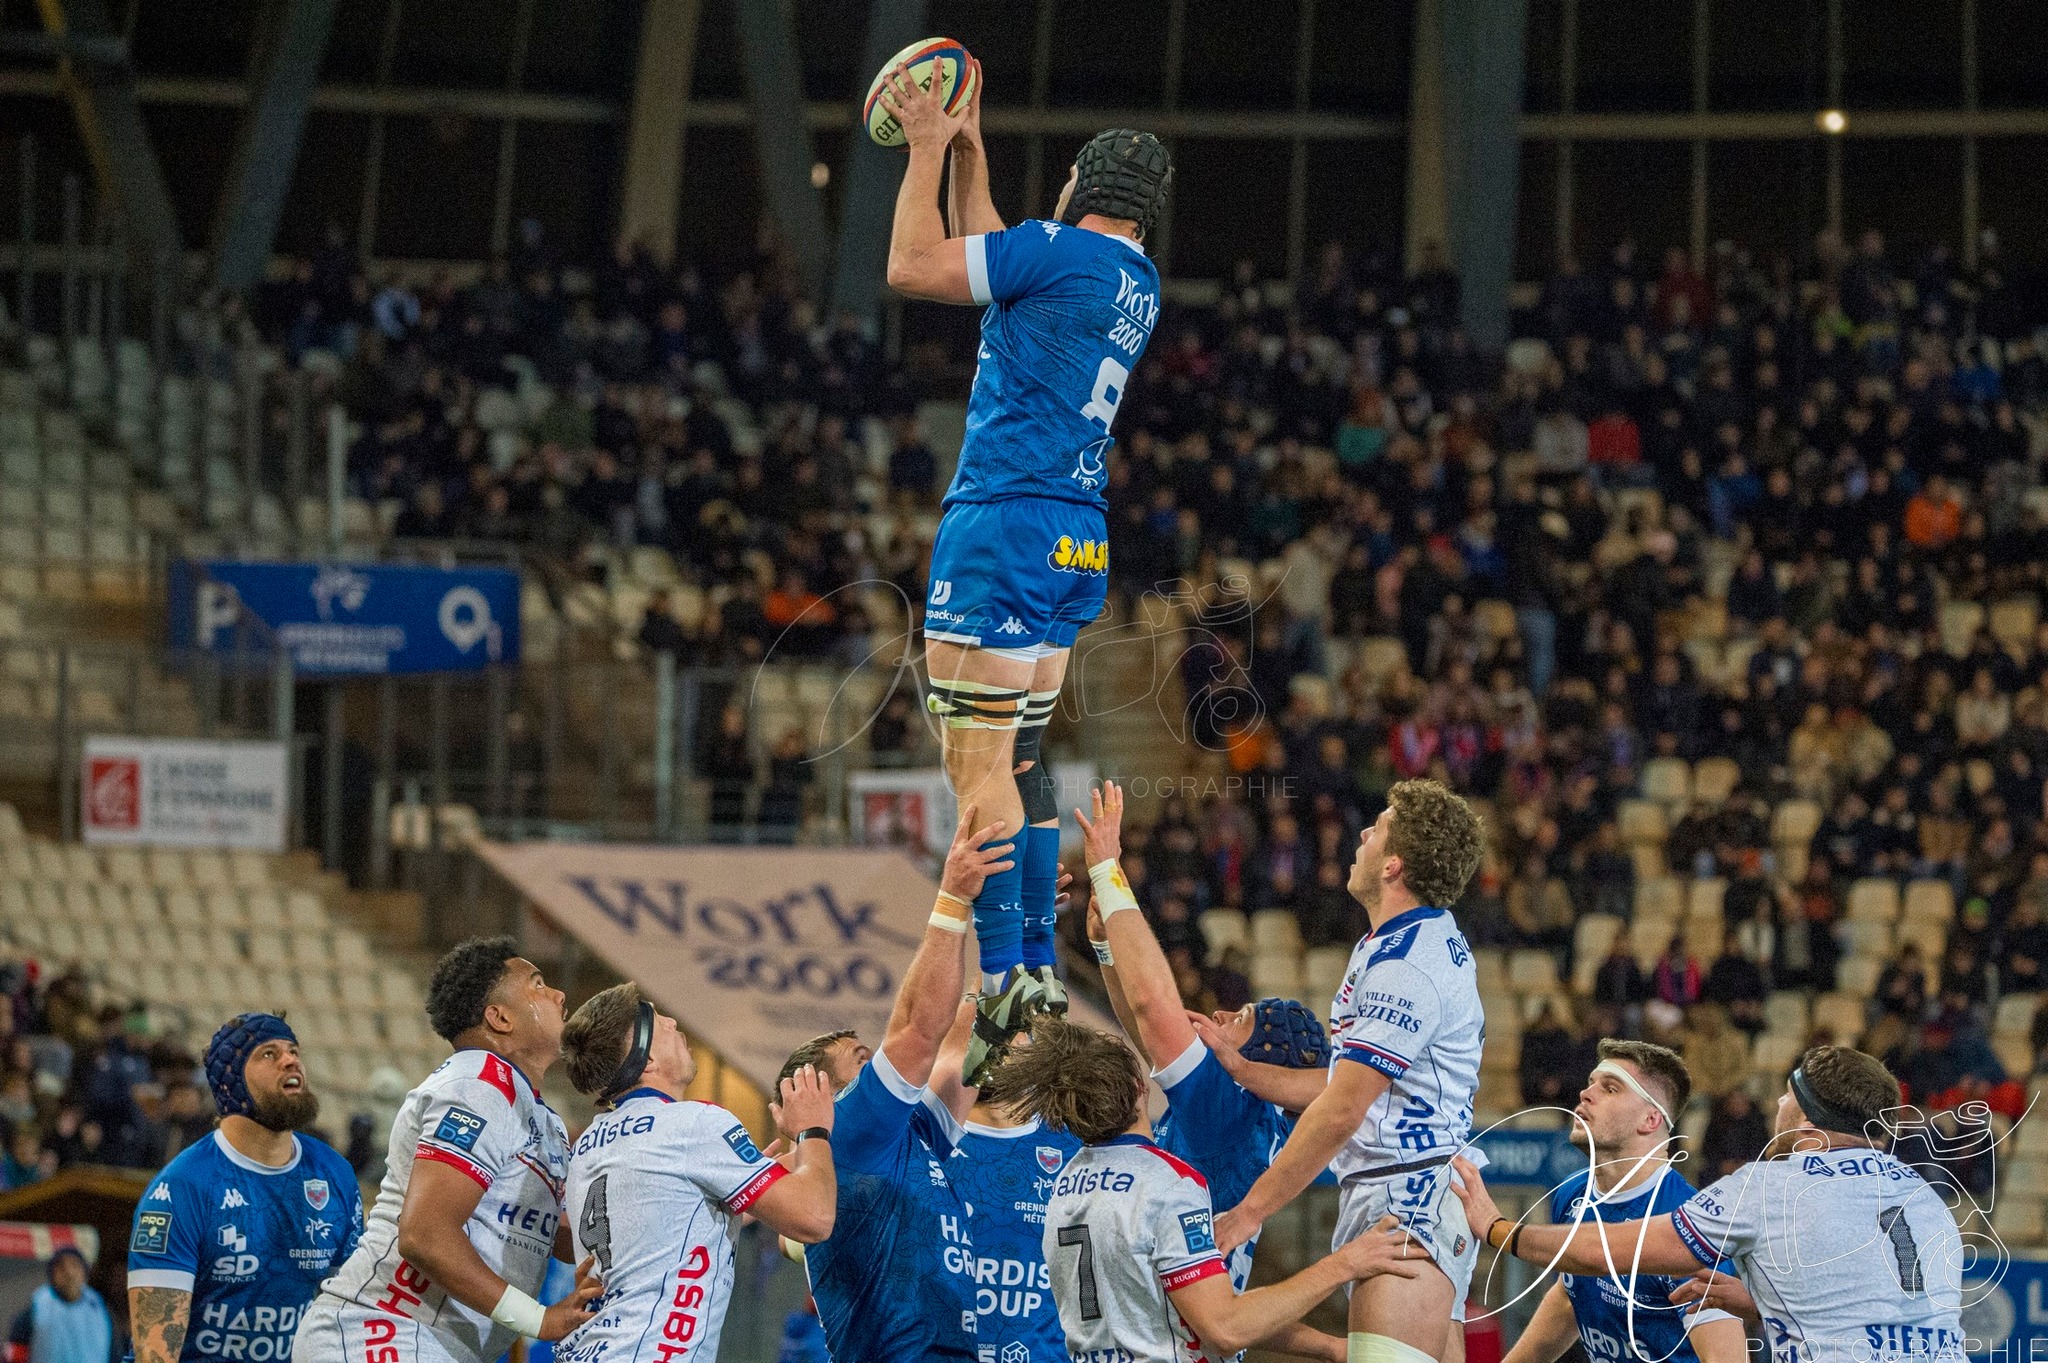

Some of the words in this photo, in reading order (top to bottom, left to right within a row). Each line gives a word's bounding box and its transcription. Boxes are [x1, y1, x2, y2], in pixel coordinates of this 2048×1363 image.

[1107, 317, 1144, 356] 2000
[562, 873, 921, 948] Work
[705, 953, 893, 998] 2000
[1365, 991, 1395, 1004] VILLE
[1397, 997, 1415, 1011] DE
[1370, 1054, 1404, 1076] ASBH
[449, 1111, 481, 1129] PRO
[438, 1124, 472, 1151] D2
[749, 1172, 772, 1196] RUGBY
[141, 1214, 166, 1226] PRO
[579, 1173, 613, 1275] 4
[1183, 1212, 1209, 1227] PRO
[137, 1233, 163, 1249] D2
[1877, 1205, 1924, 1292] 1
[212, 1254, 260, 1276] SD
[1693, 1243, 1715, 1264] RUGBY
[1057, 1224, 1102, 1322] 7
[1173, 1268, 1201, 1284] RUGBY
[195, 1329, 295, 1362] GROU
